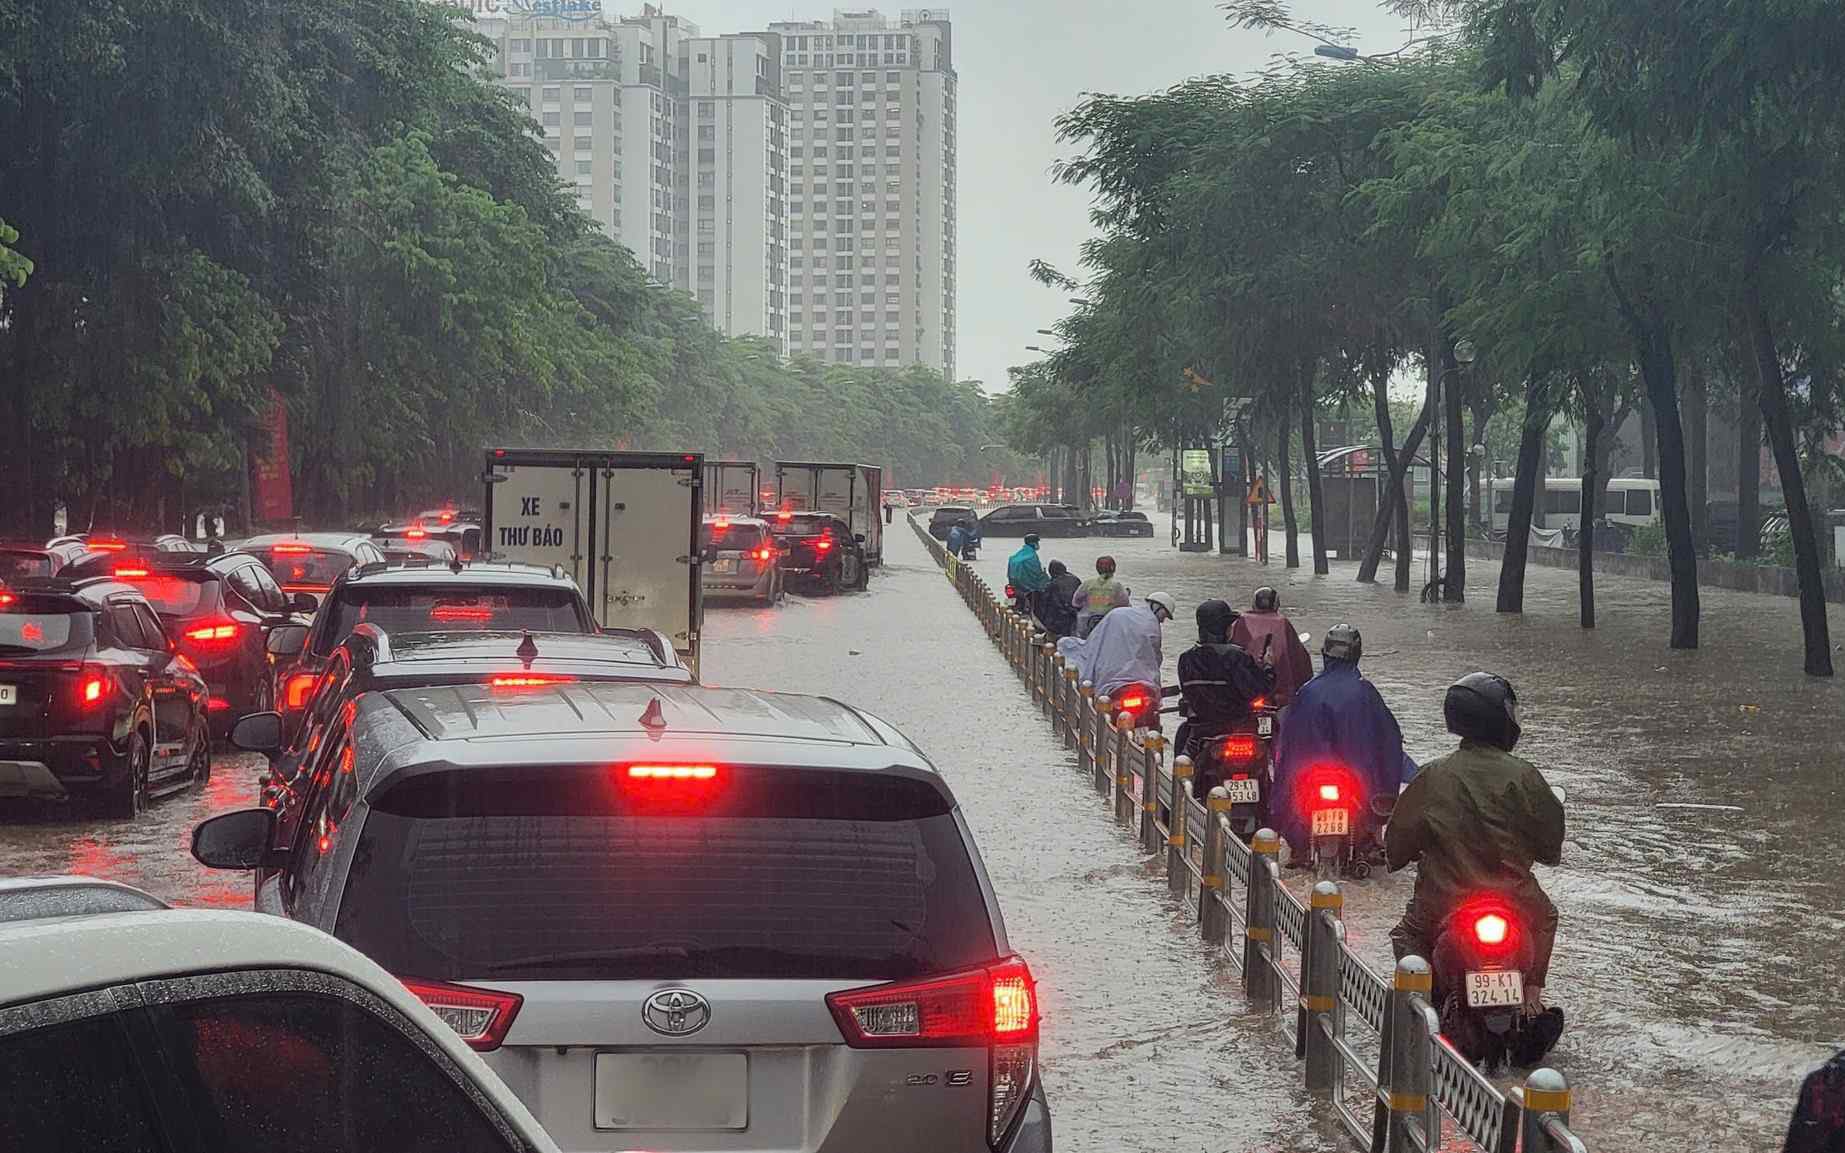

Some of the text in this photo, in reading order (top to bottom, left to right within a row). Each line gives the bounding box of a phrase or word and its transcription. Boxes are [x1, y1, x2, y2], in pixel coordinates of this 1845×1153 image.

[521, 497, 540, 516] XE
[499, 524, 563, 546] THƯ BÁO
[1232, 791, 1257, 801] 53.48
[1472, 988, 1519, 1005] 324.14
